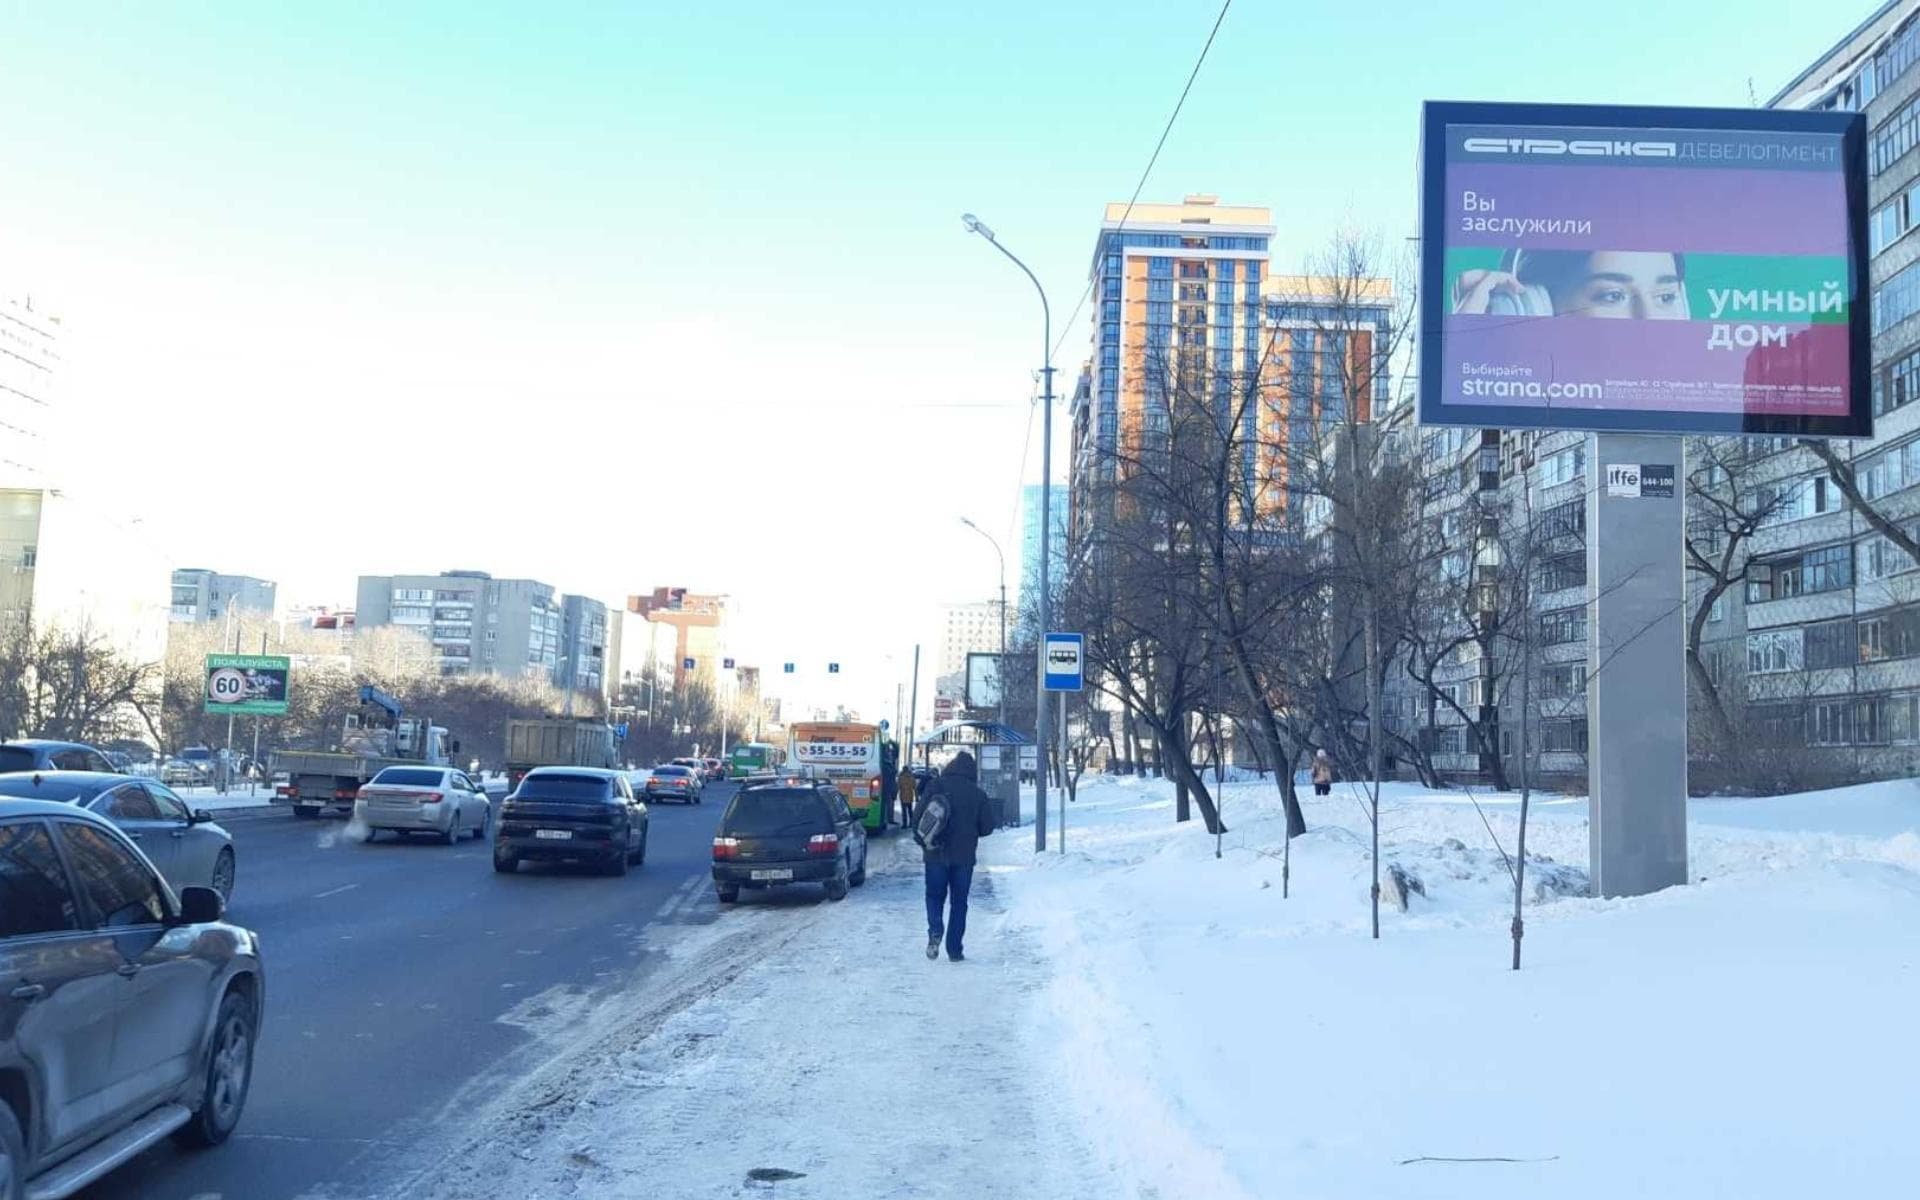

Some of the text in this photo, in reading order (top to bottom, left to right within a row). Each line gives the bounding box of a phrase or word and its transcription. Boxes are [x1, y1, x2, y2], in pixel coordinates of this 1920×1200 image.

[1679, 142, 1836, 162] ДЕВЕЛОПМЕНТ
[1463, 191, 1495, 211] Вы
[1462, 216, 1591, 237] заслужили
[1706, 281, 1842, 318] умный
[1707, 323, 1787, 350] дом
[1462, 362, 1533, 377] Выбирайте
[1462, 378, 1602, 398] strana.com
[216, 677, 240, 693] 60
[809, 745, 867, 756] 55-55-55
